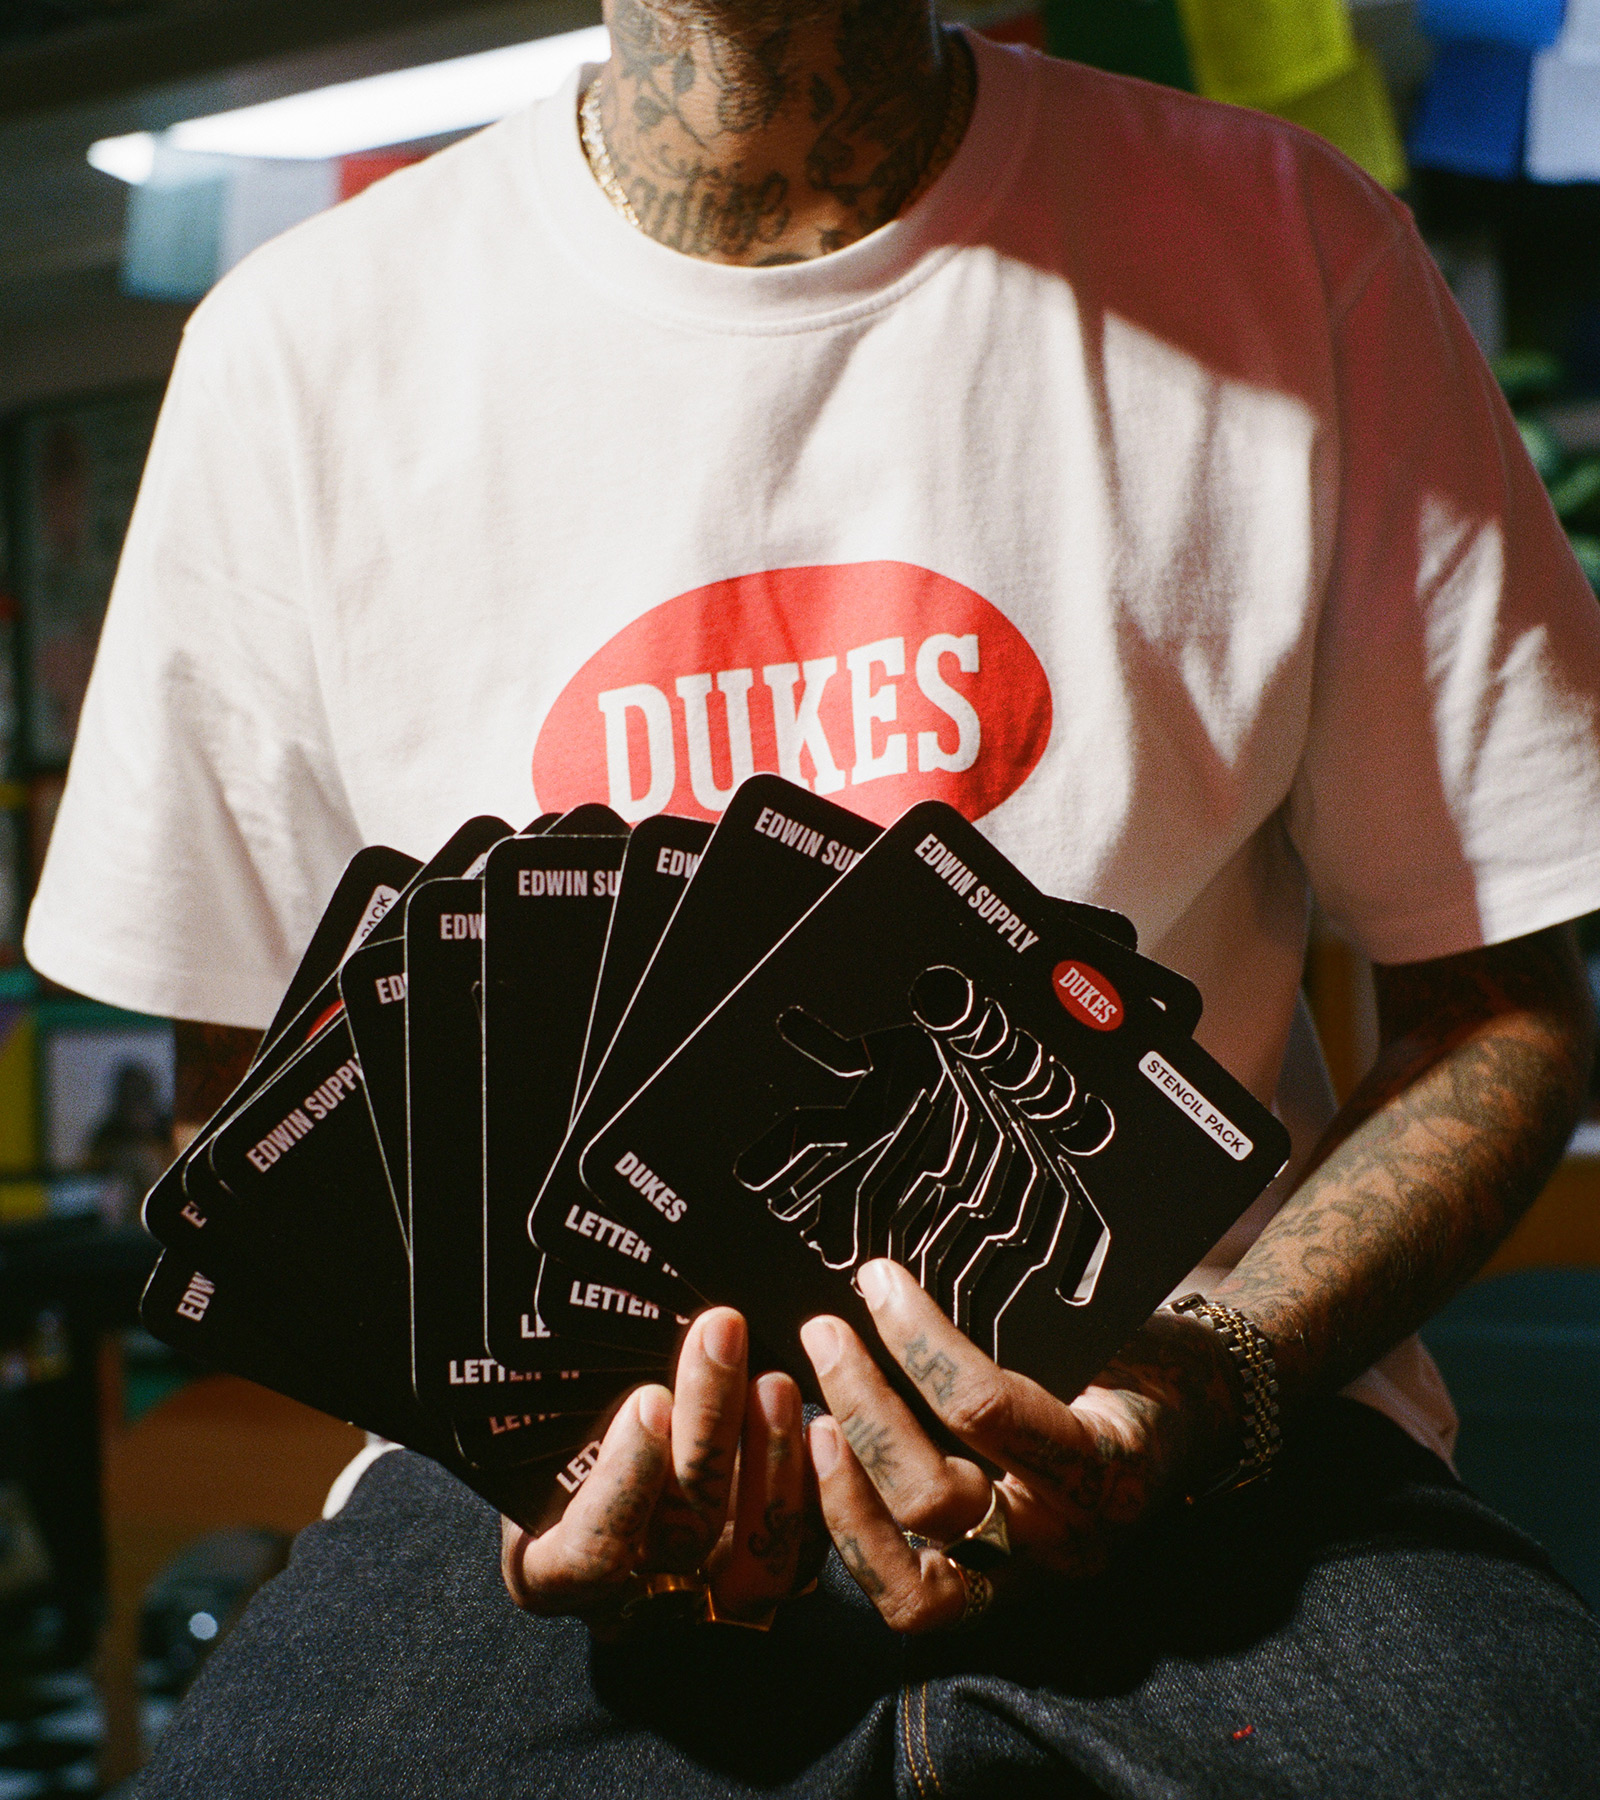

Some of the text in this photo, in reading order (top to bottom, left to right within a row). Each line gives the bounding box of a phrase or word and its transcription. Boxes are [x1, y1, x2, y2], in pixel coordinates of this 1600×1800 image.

[598, 633, 981, 823] DUKES
[754, 806, 825, 859] EDWIN
[518, 869, 588, 897] EDWIN
[914, 832, 1040, 954] EDWIN SUPPLY
[1058, 967, 1118, 1024] DUKES
[245, 1107, 315, 1173] EDWIN
[1147, 1059, 1245, 1153] STENCIL PACK
[614, 1150, 688, 1223] DUKES
